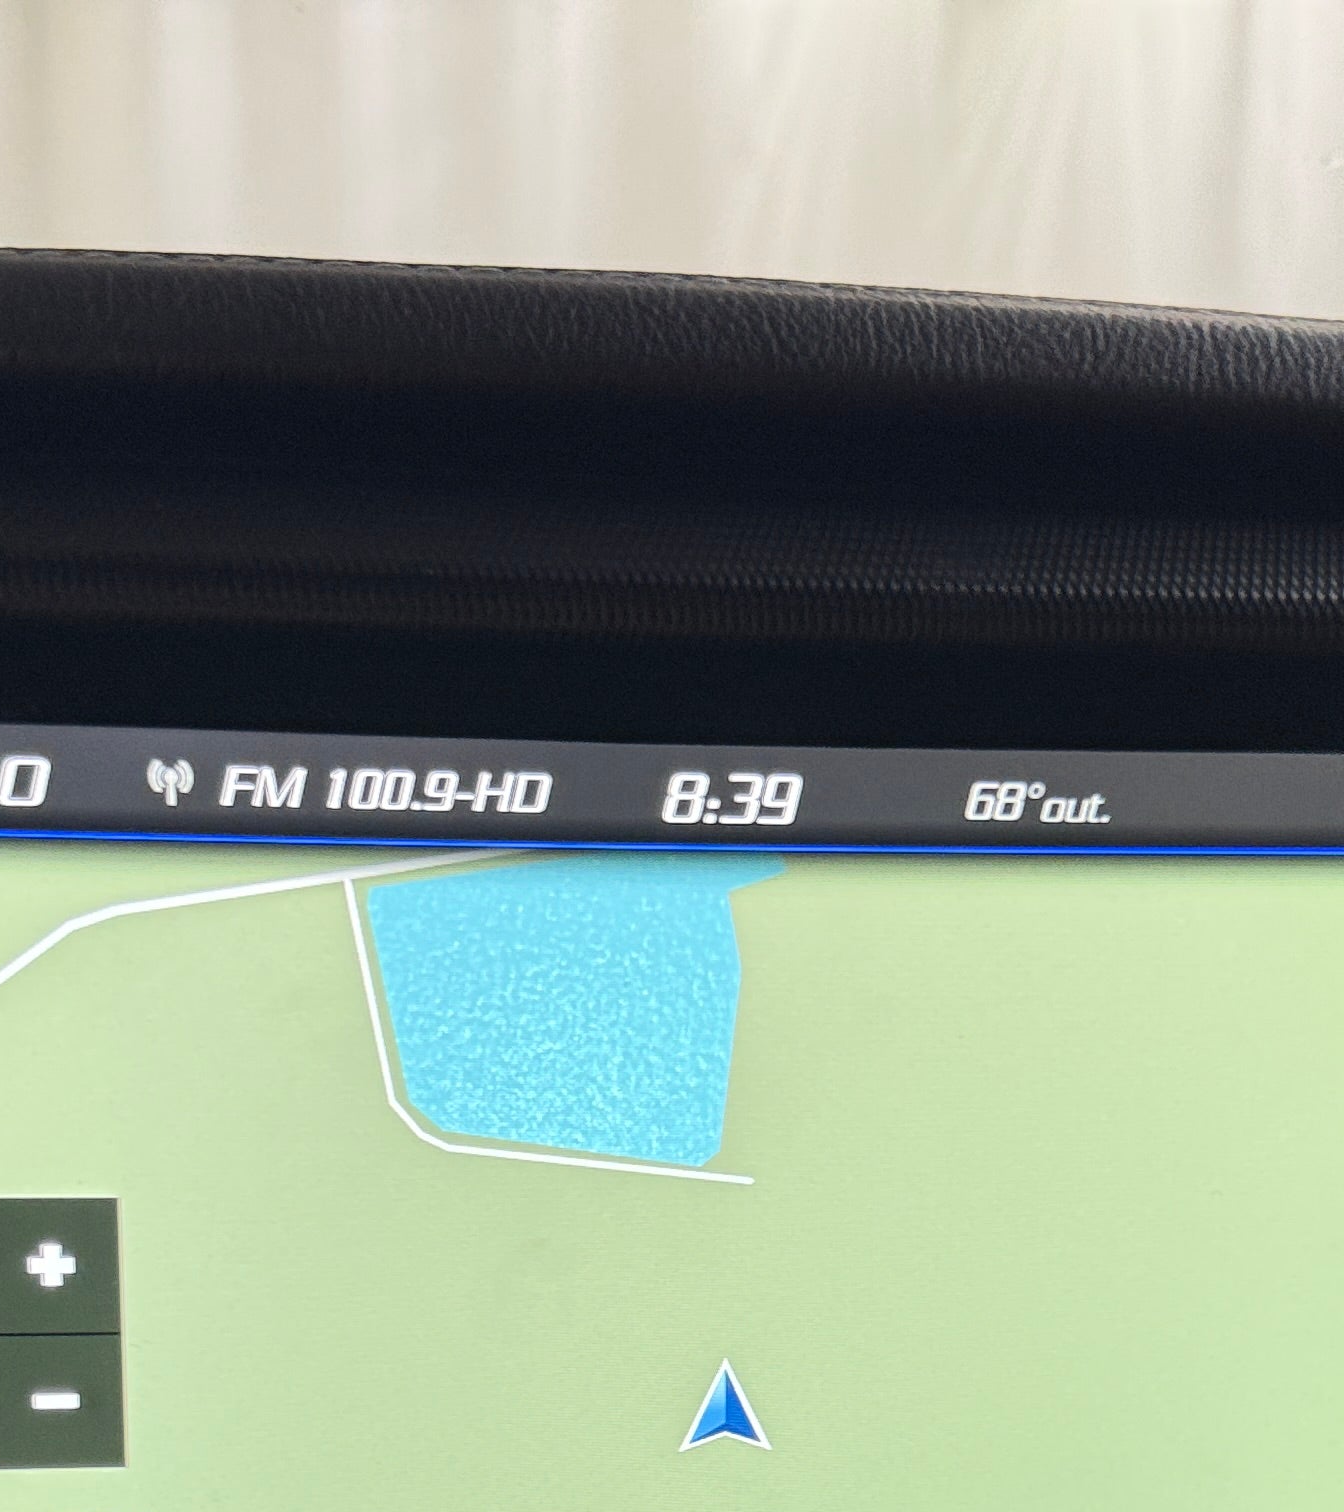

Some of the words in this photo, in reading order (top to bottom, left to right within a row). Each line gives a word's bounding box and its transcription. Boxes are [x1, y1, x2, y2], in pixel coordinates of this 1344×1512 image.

[220, 764, 302, 810] FM
[325, 768, 554, 815] 100.9-HD
[661, 771, 804, 827] 8:39
